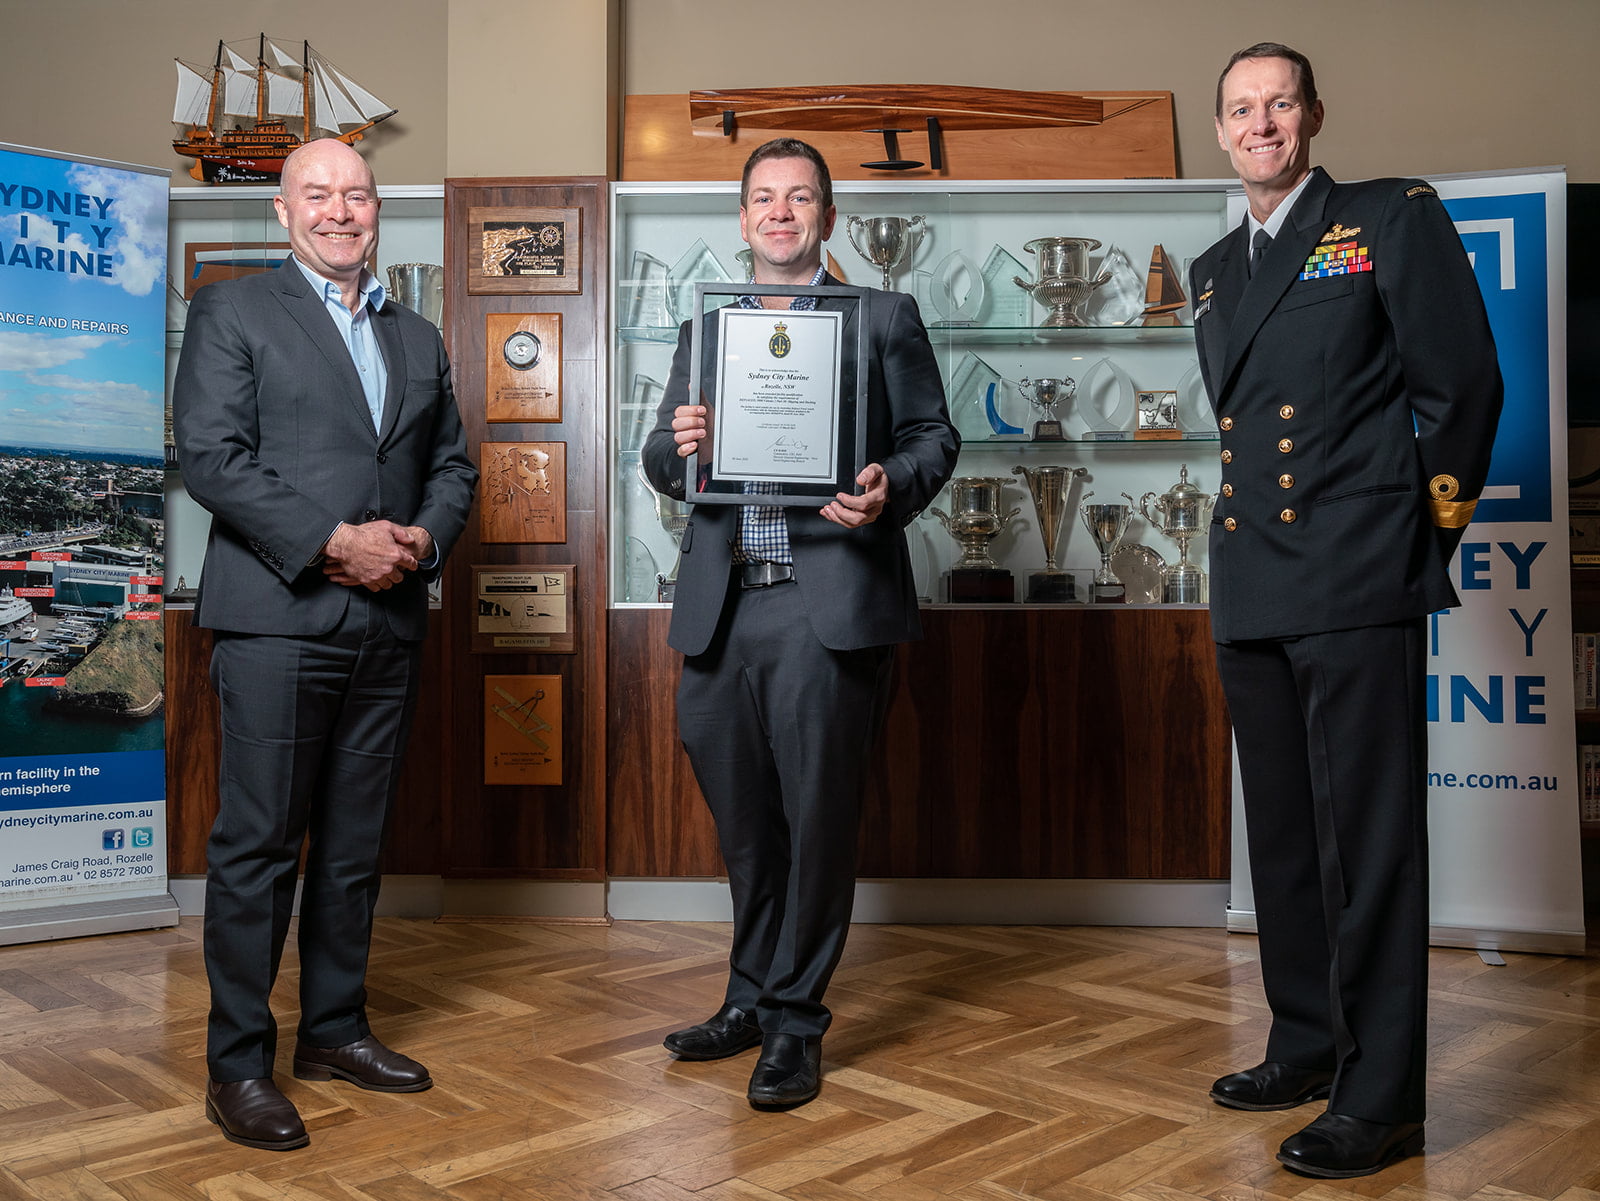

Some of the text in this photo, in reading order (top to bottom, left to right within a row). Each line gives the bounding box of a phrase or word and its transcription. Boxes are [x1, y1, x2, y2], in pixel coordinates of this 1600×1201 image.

[0, 241, 112, 278] ARINE
[0, 312, 130, 335] ANCE AND REPAIRS
[748, 372, 771, 381] Sydney
[1460, 542, 1548, 590] EY
[16, 767, 60, 780] facility
[64, 766, 75, 777] in
[79, 766, 100, 776] the
[0, 783, 71, 796] emisphere
[12, 853, 153, 873] James Craig Road, Rozelle
[84, 870, 97, 880] 02
[100, 868, 125, 878] 8572
[128, 865, 153, 875] 7800
